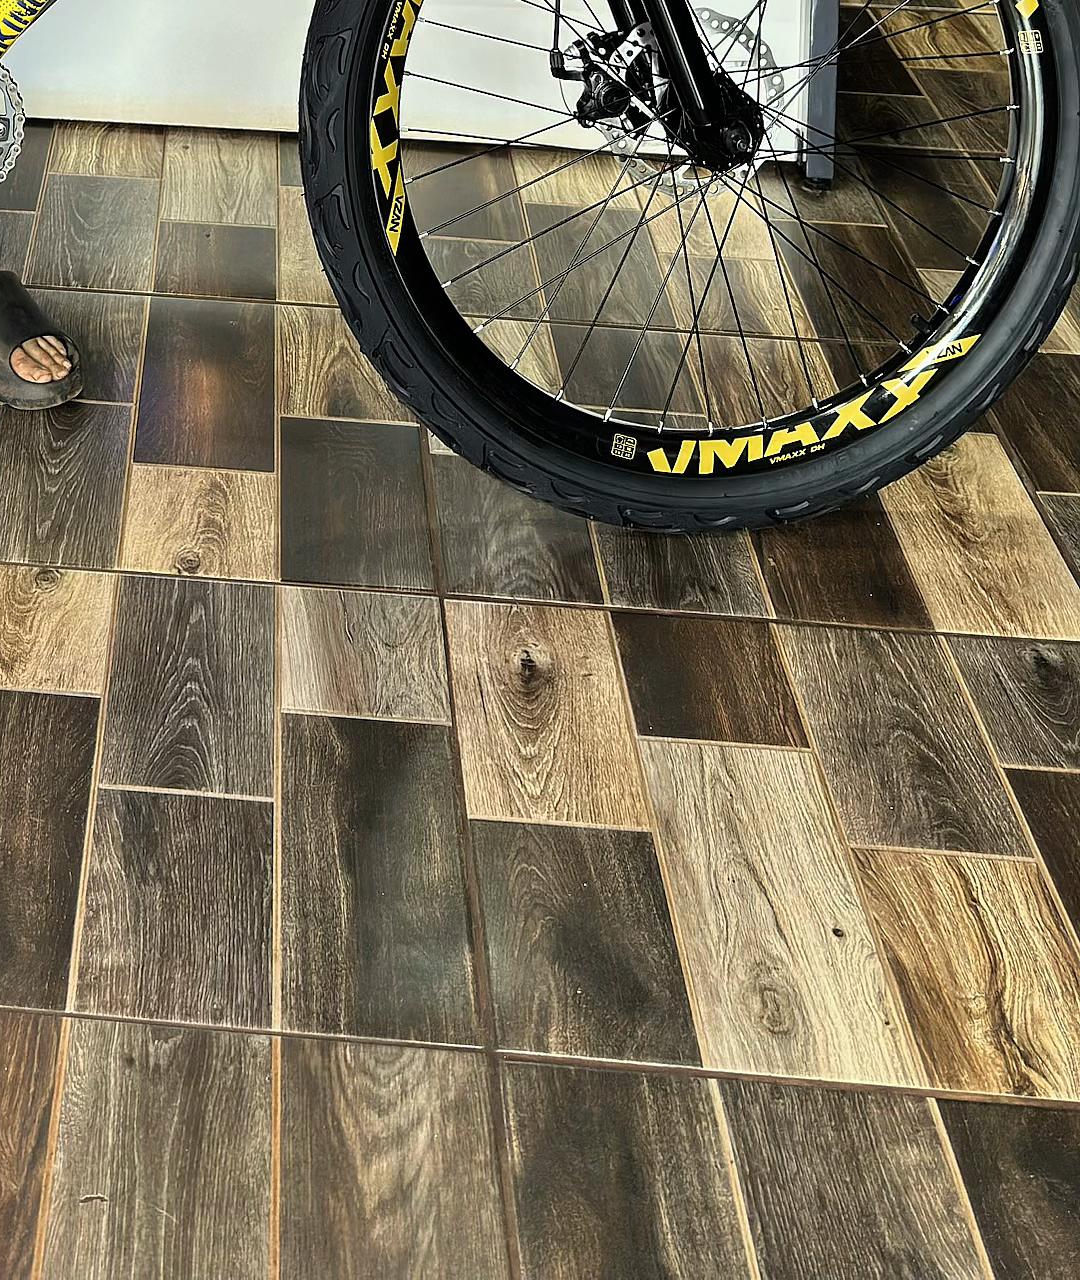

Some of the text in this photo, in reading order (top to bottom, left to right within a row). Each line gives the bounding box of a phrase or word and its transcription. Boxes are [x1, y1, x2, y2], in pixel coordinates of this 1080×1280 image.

[386, 1, 403, 40] VMAXX
[646, 368, 939, 475] VMAXX
[768, 442, 827, 466] VMAXX DH
